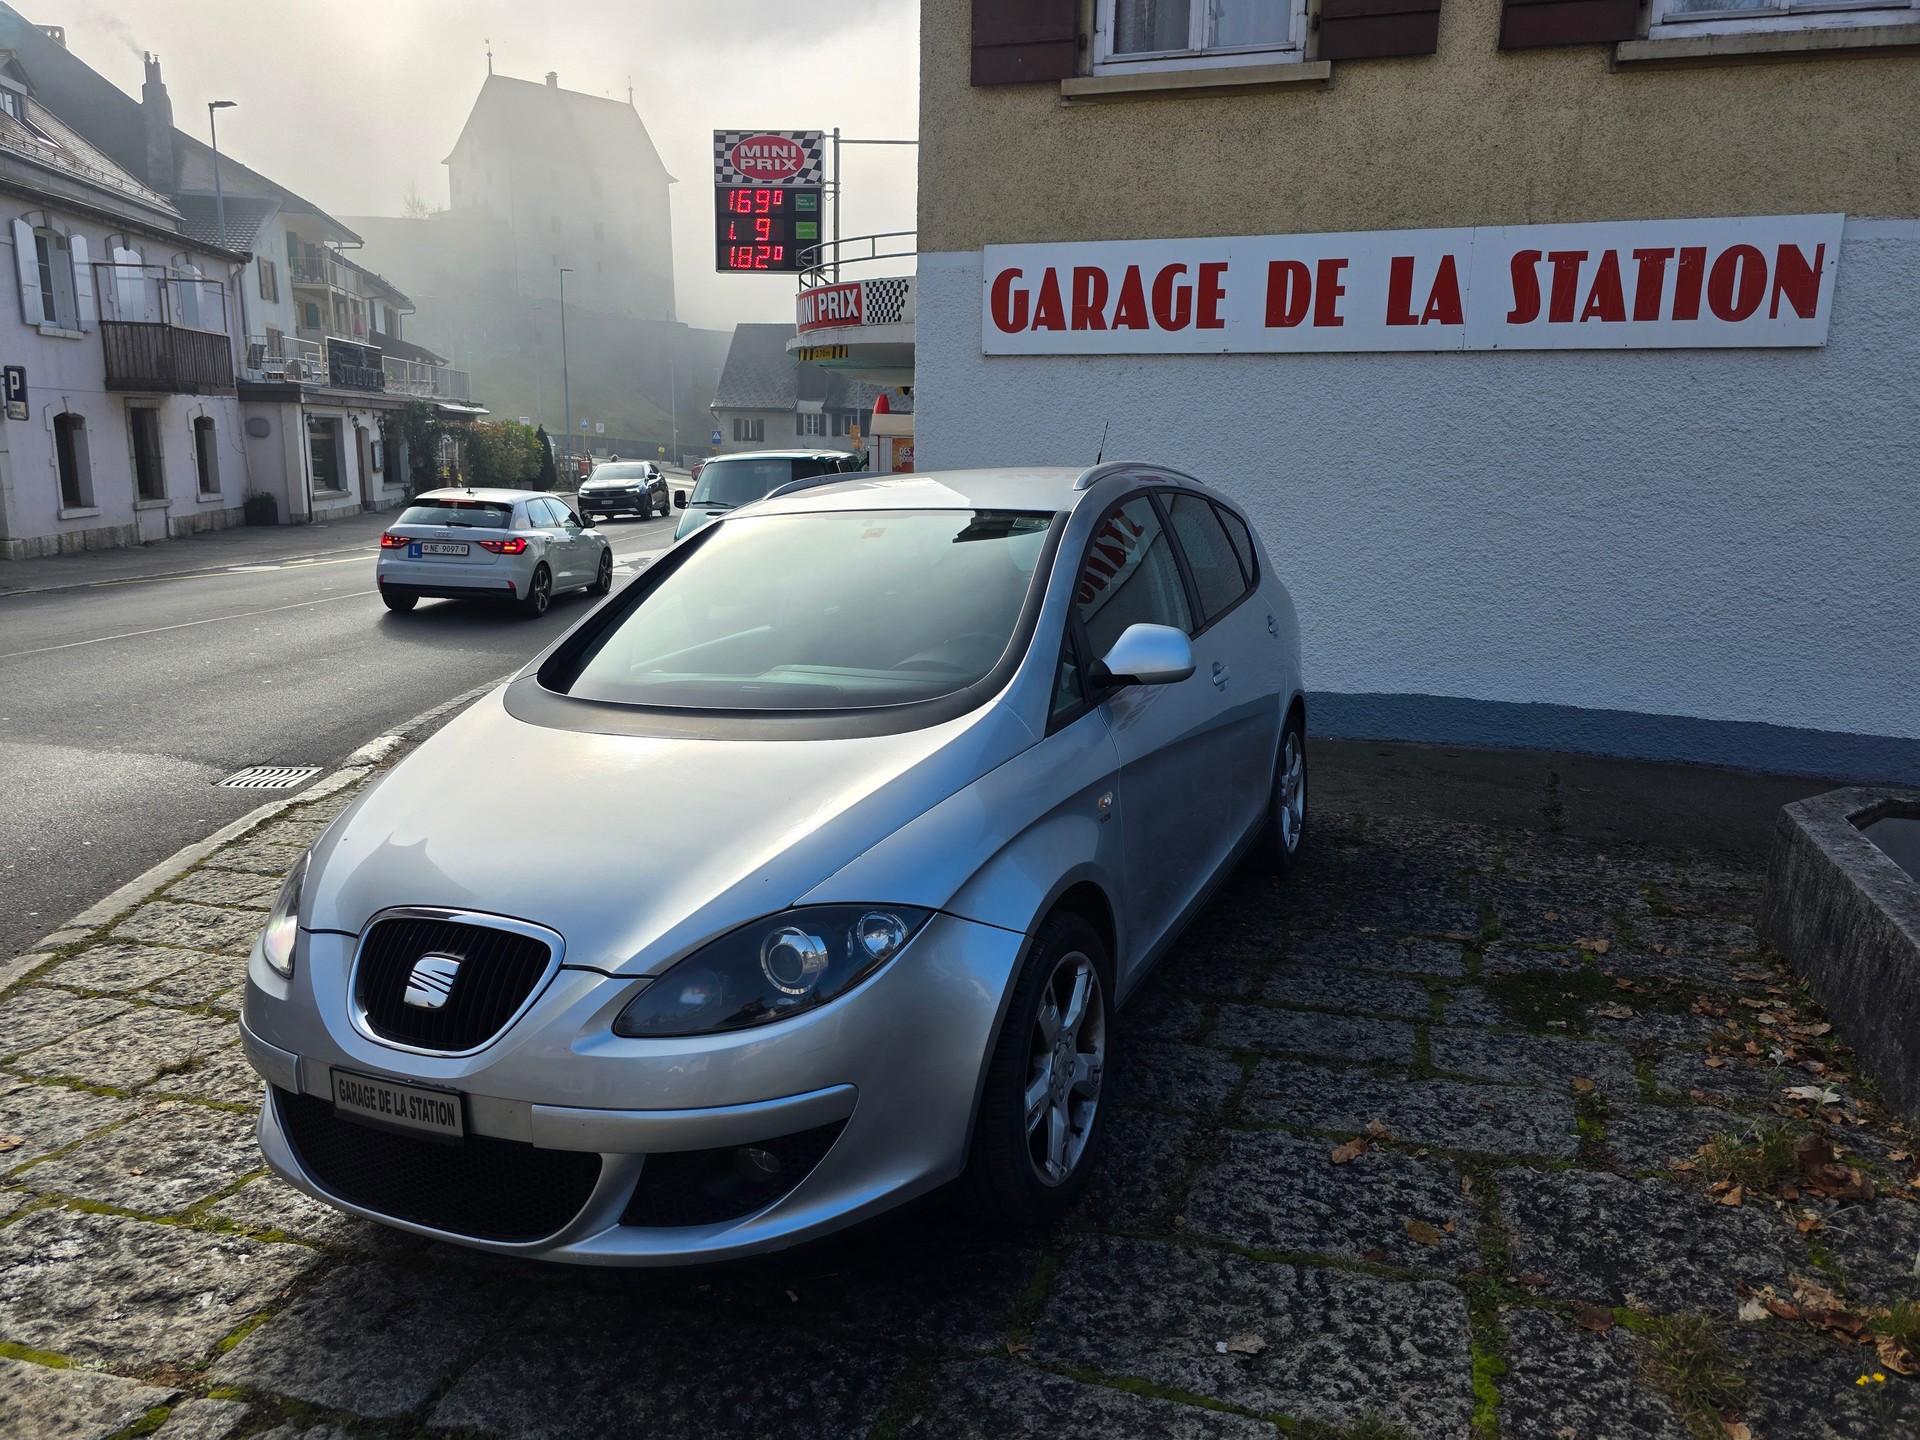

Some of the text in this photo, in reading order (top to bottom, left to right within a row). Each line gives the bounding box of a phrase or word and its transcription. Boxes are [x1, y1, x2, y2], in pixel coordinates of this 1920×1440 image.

[739, 144, 797, 158] MINI
[739, 158, 798, 171] PRIX
[818, 288, 860, 321] PRIX
[990, 242, 1826, 334] GARAGE DE LA STATION
[338, 1079, 456, 1128] GARAGE DE LA STATION
